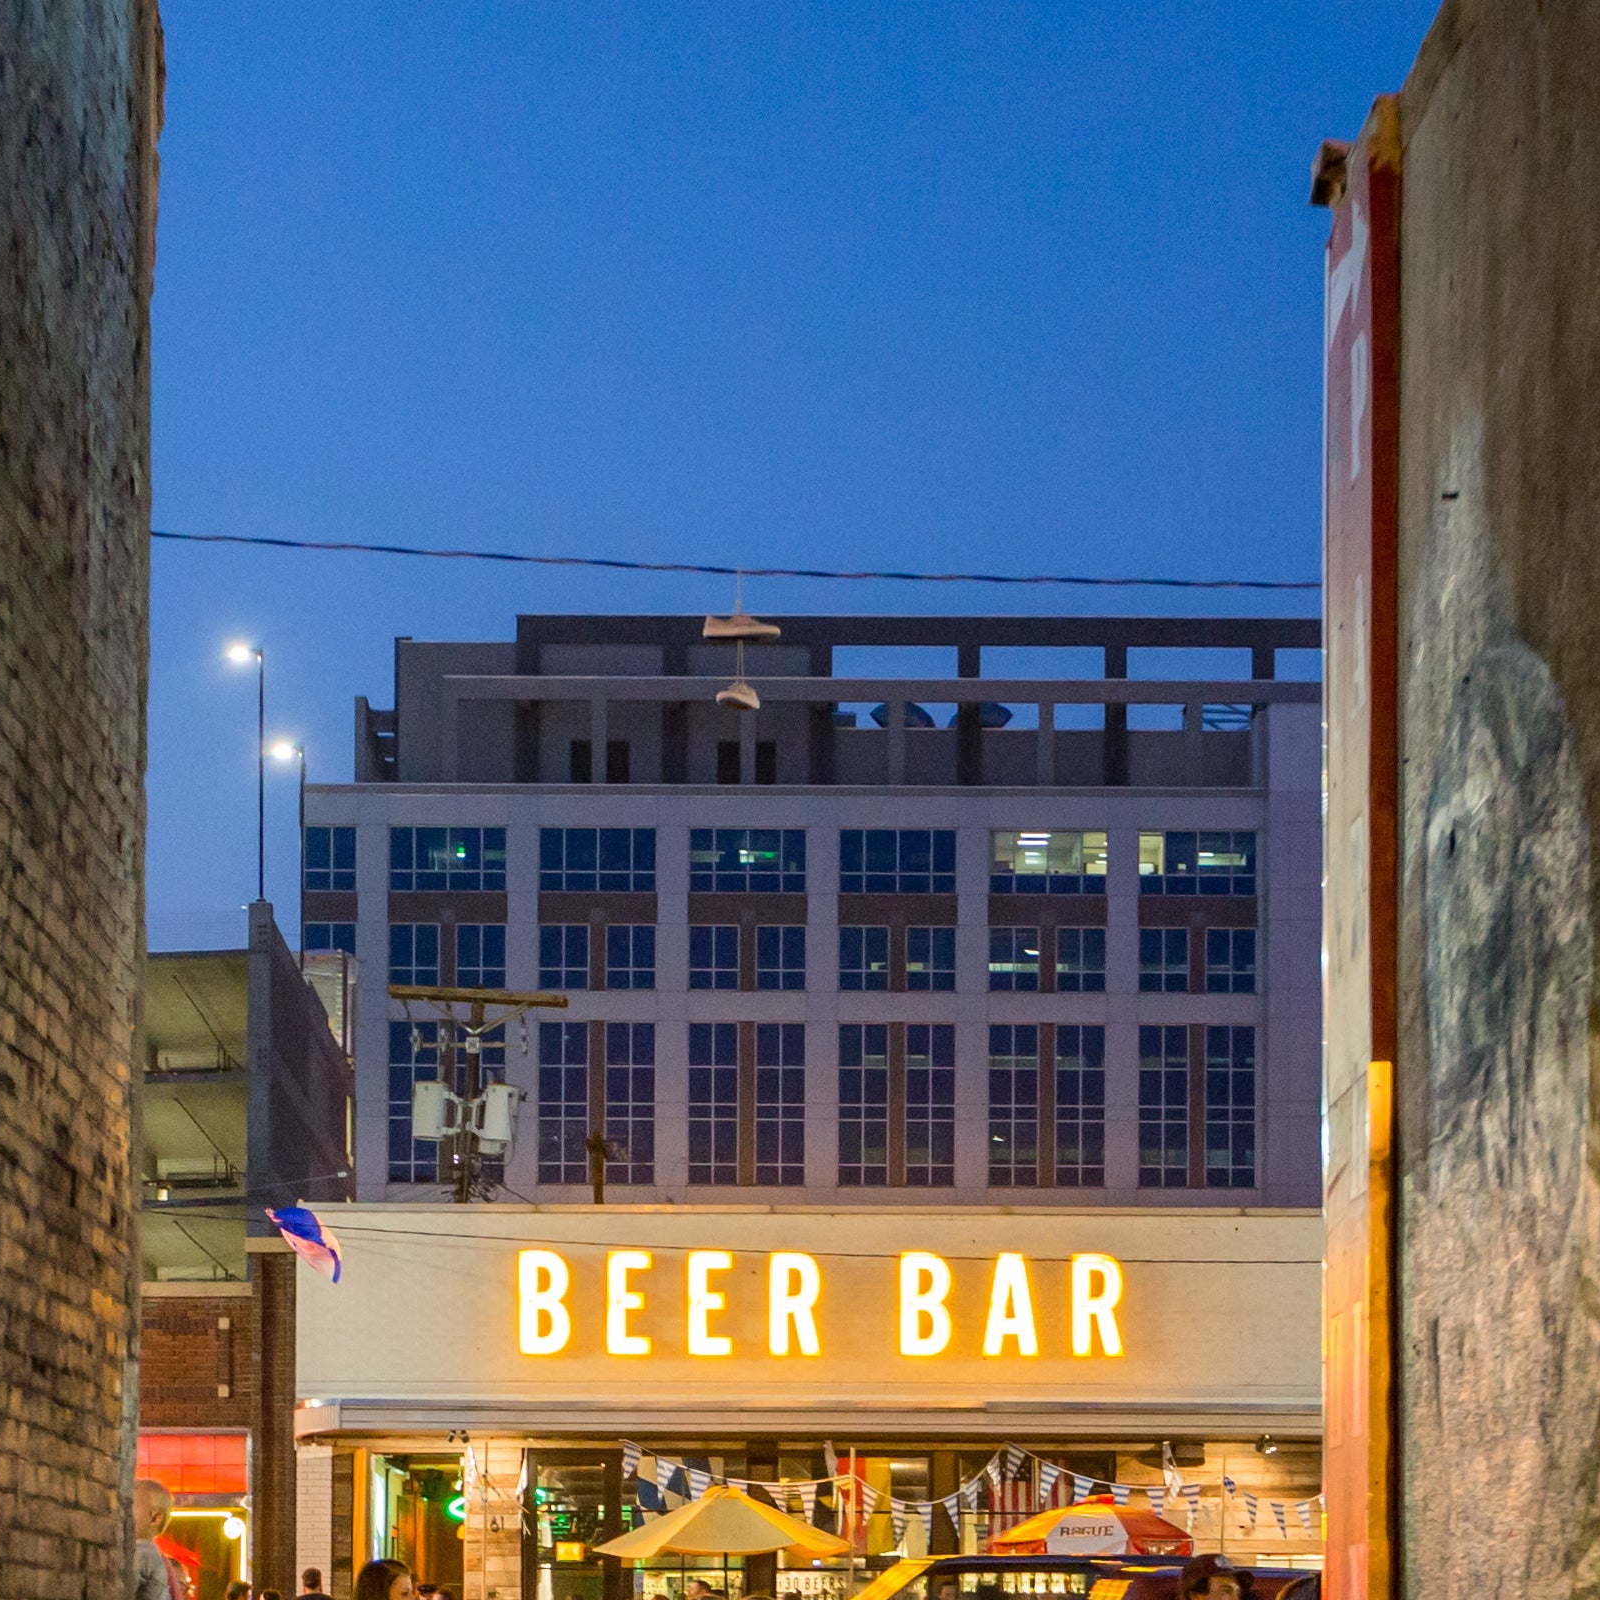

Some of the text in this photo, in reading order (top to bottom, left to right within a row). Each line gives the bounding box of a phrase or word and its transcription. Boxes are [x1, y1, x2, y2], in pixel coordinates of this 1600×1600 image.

[517, 1249, 1124, 1357] BEER BAR
[1059, 1525, 1114, 1537] ROGUE
